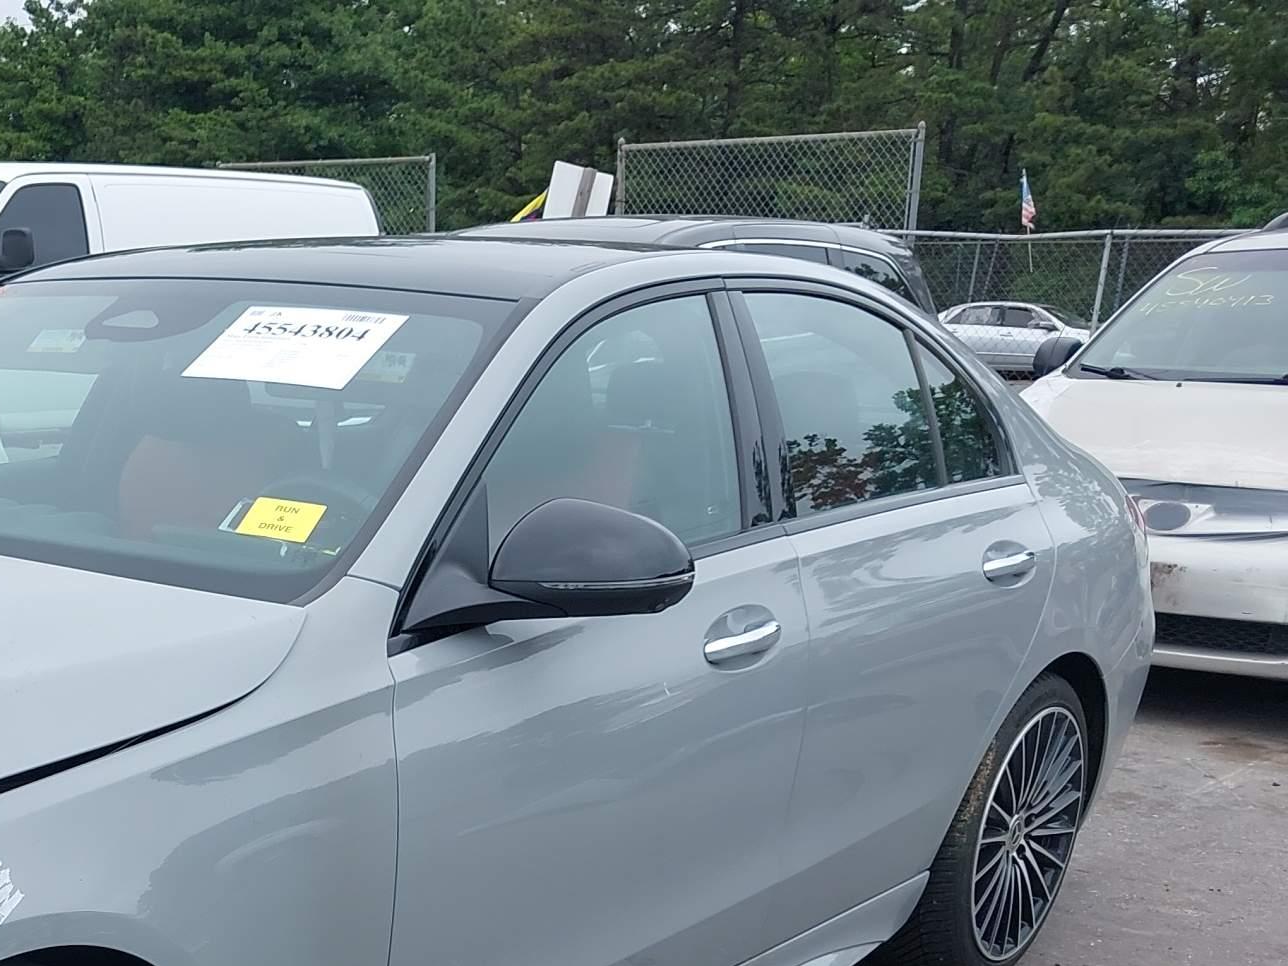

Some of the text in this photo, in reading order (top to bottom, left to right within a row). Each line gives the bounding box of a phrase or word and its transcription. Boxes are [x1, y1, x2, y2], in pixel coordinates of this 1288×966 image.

[243, 320, 372, 342] 45543804
[275, 504, 301, 514] RUN
[258, 522, 294, 533] DRIVE
